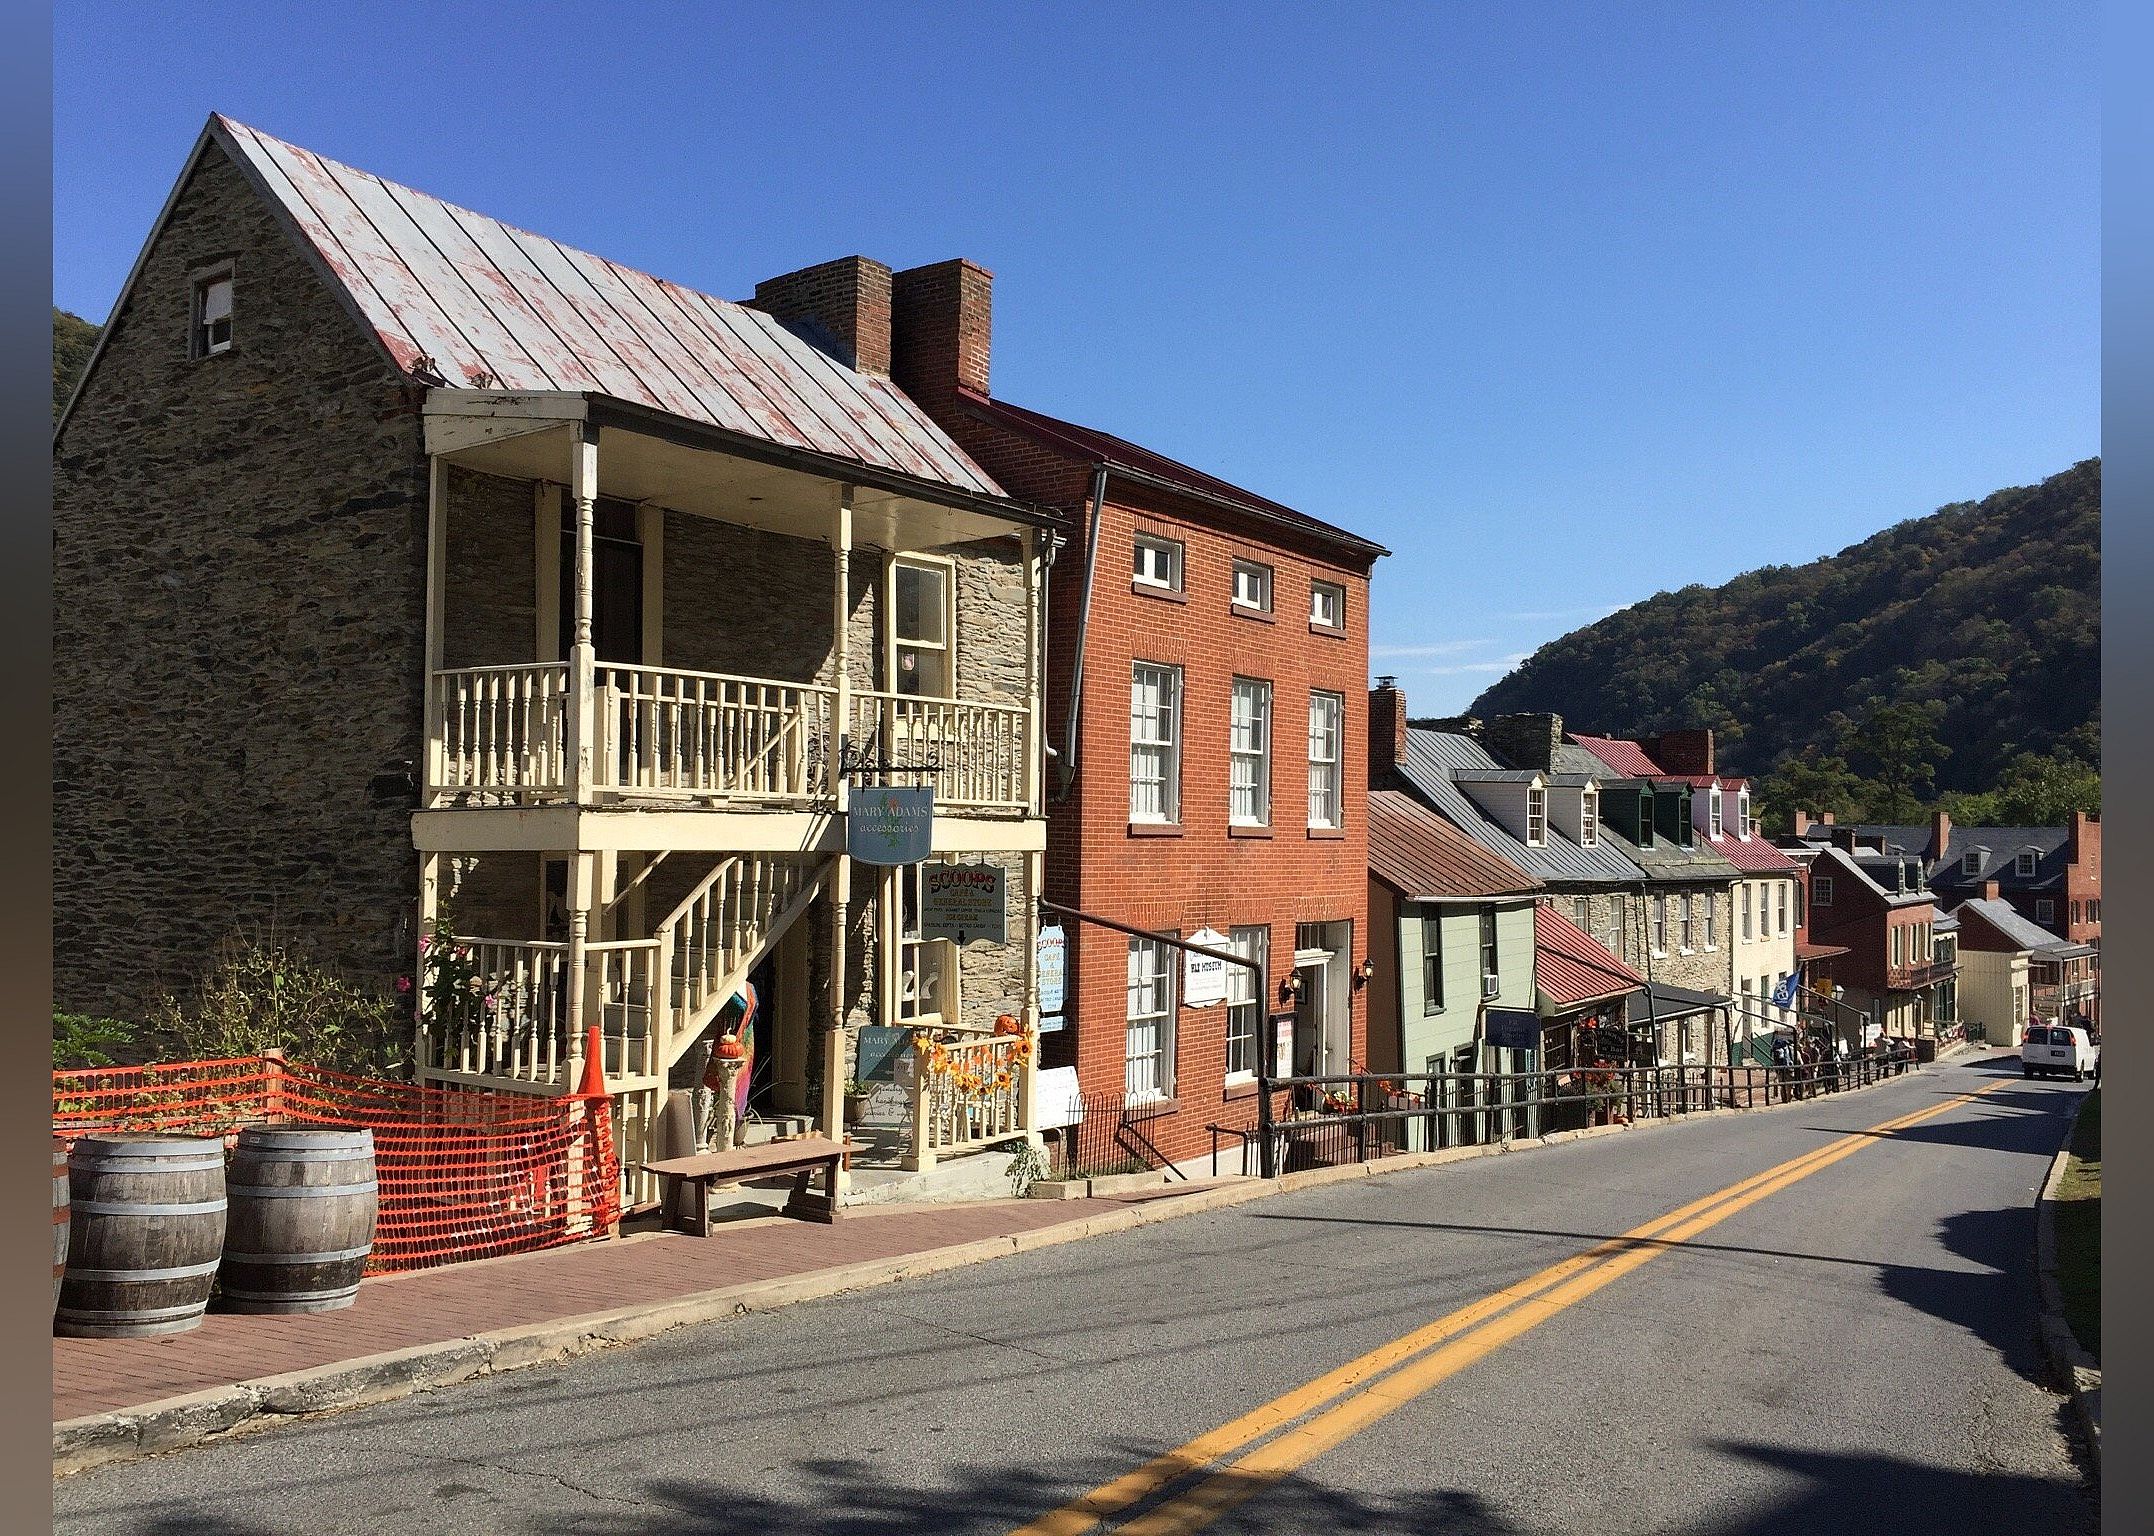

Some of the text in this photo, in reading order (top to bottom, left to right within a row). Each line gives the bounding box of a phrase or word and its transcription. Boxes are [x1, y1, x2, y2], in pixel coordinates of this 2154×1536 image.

[853, 806, 928, 817] MARY ADAMS
[860, 822, 919, 833] accessories
[928, 869, 996, 894] SCOOPS
[864, 1036, 889, 1045] MARY
